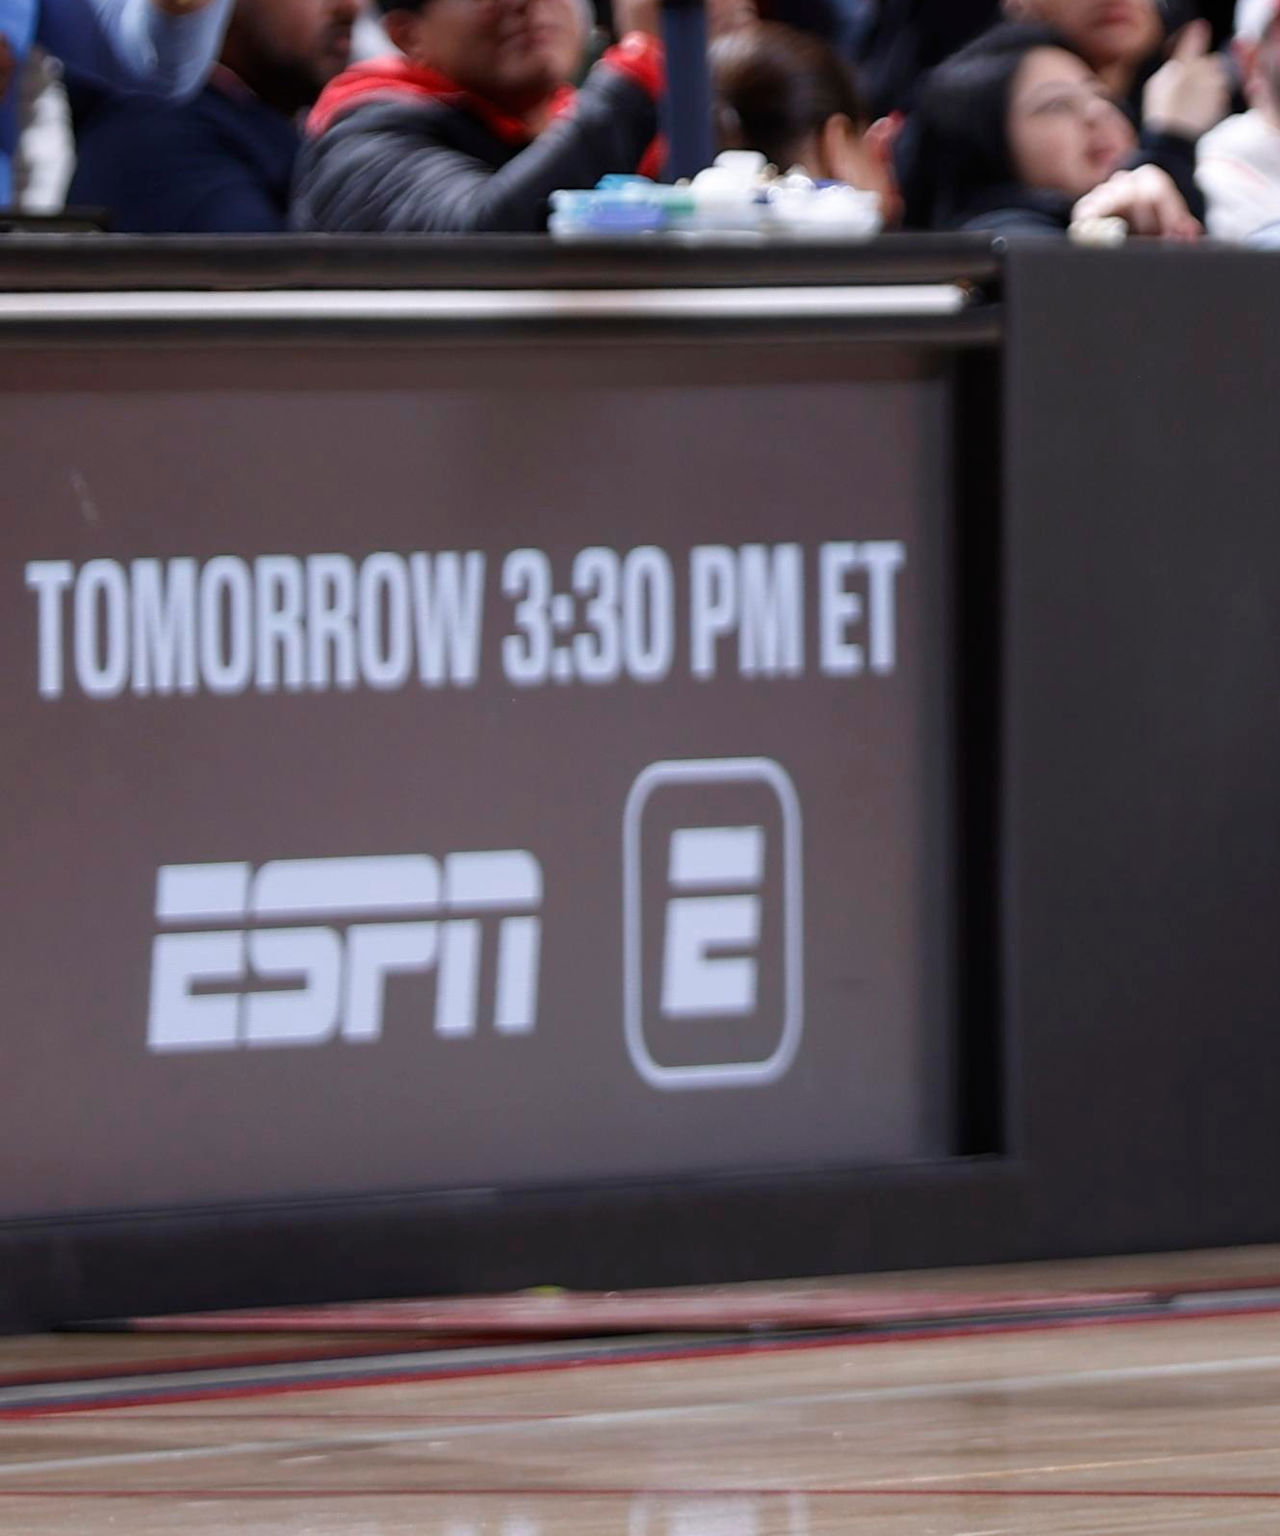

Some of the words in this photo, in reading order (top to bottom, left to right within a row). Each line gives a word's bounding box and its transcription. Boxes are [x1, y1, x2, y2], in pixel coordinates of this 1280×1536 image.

[26, 552, 485, 699] TOMORROW
[501, 546, 674, 685] 3:30
[690, 542, 803, 681] PM
[818, 539, 906, 677] ET
[147, 848, 544, 1054] ESPN
[661, 825, 765, 1020] E
